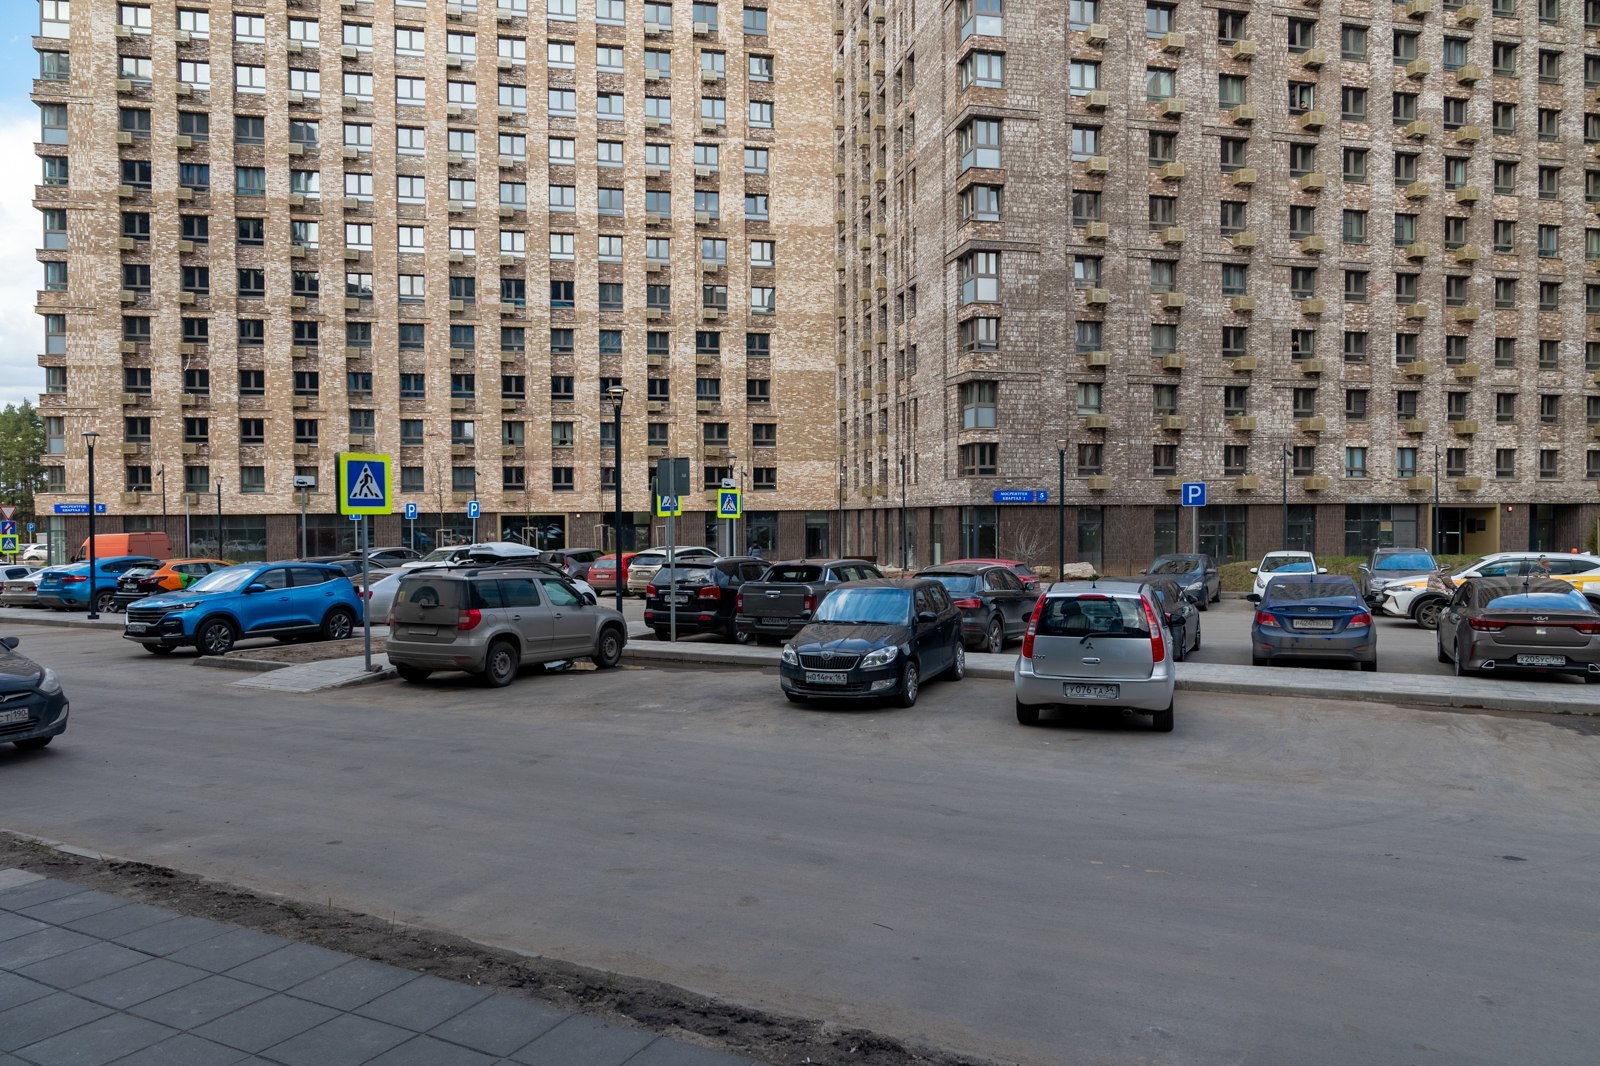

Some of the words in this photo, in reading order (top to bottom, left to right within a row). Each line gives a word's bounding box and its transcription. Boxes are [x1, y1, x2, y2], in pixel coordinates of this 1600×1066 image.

[1188, 485, 1202, 504] P
[408, 504, 416, 517] P
[470, 502, 478, 517] P
